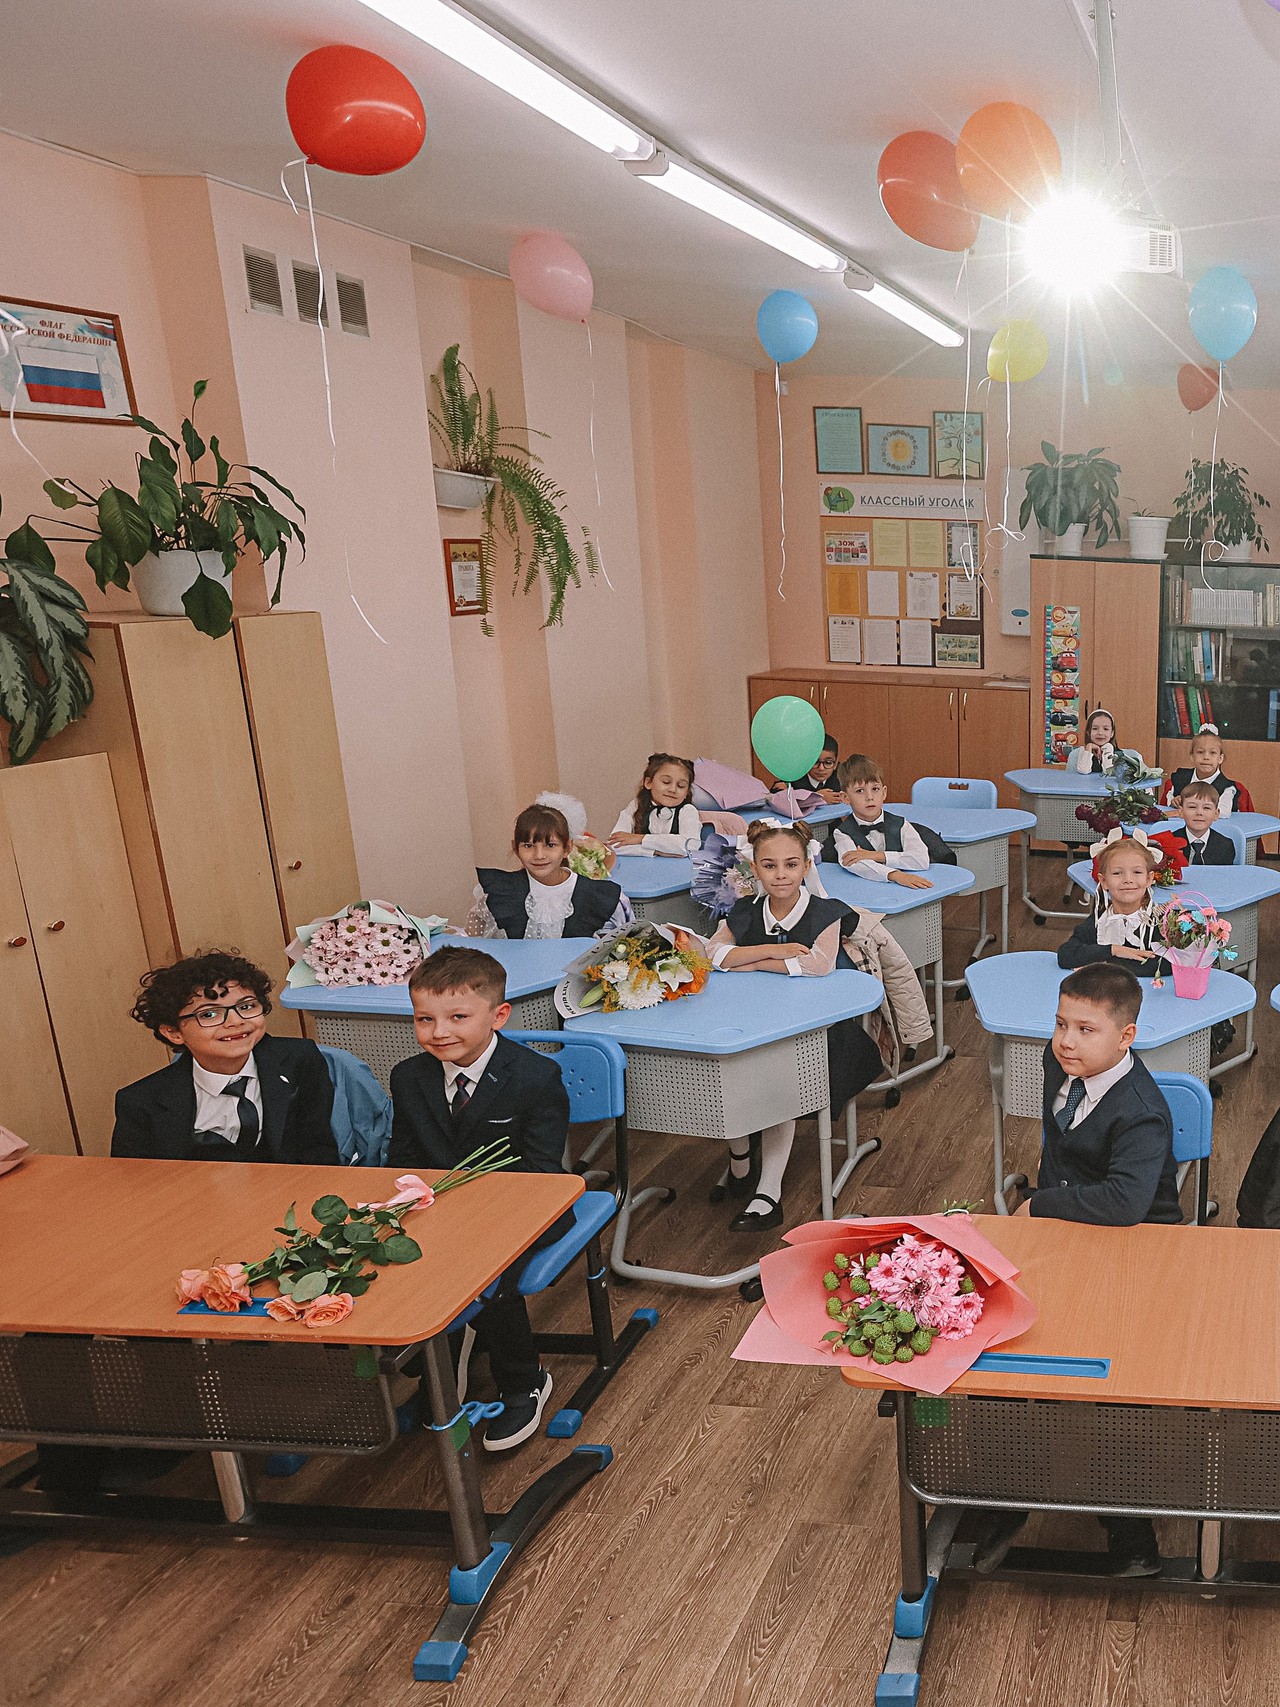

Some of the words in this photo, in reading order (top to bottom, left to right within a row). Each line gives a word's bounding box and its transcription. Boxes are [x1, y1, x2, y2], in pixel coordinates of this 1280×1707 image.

[39, 319, 66, 330] ФЛАГ
[57, 332, 112, 347] ФЕДЕРАЦИИ
[860, 494, 926, 507] КЛАССНЫЙ
[928, 497, 975, 508] УГОЛОК
